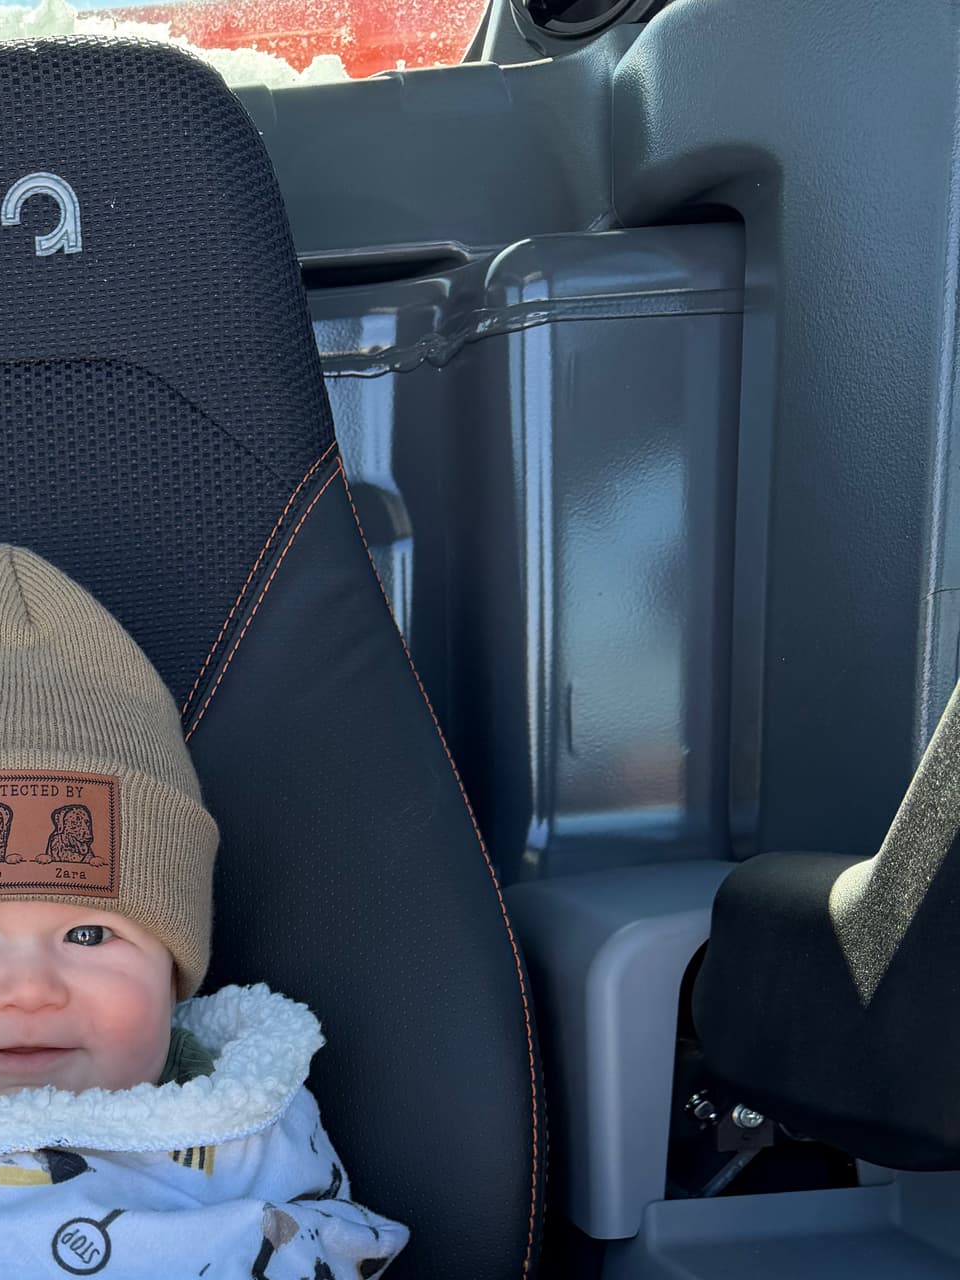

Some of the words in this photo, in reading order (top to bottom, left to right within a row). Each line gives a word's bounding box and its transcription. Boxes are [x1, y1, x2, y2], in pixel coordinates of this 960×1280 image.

[66, 786, 84, 798] BY
[55, 867, 87, 880] Zara
[60, 1228, 101, 1264] STOP
